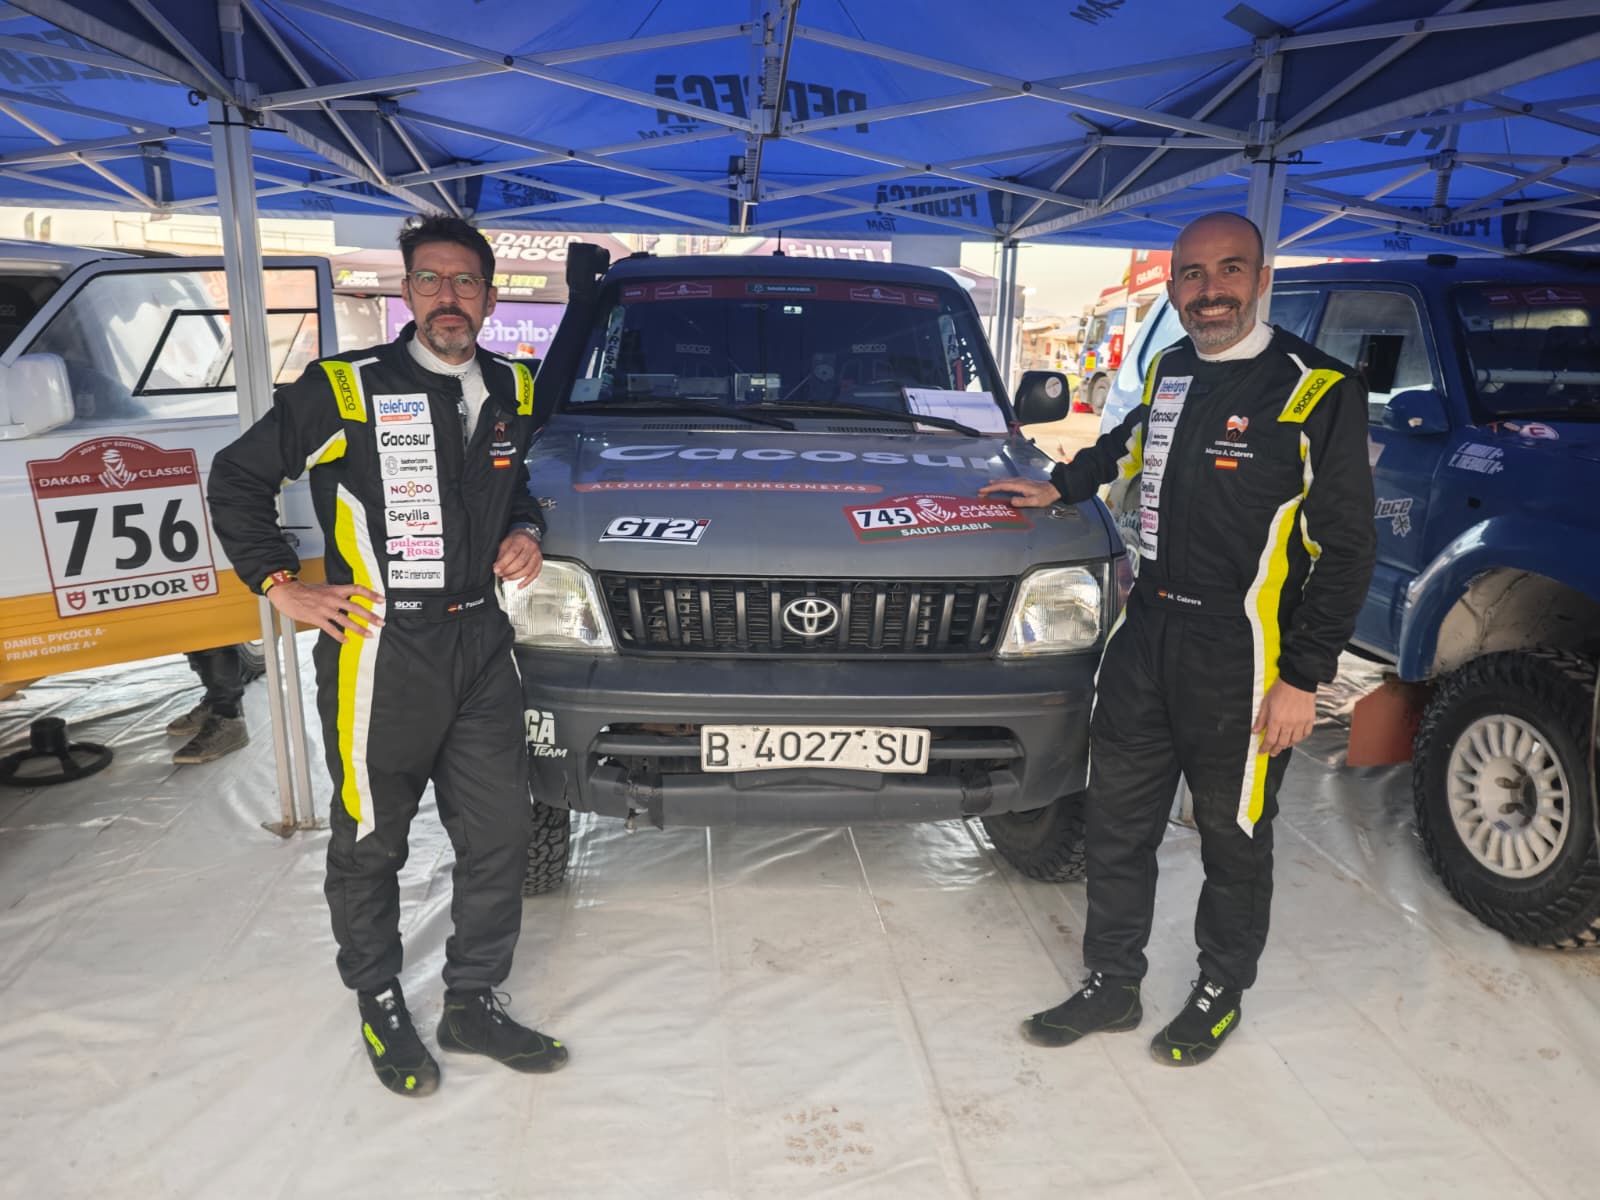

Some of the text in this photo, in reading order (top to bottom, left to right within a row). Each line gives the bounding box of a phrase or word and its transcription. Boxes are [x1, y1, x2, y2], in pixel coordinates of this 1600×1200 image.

[333, 368, 356, 412] sparco
[1293, 378, 1327, 415] sparco
[379, 399, 425, 417] telefurgo
[114, 441, 145, 451] EDITION
[38, 465, 193, 488] DAKAR CLASSIC
[735, 483, 867, 491] FURGONETAS
[388, 509, 430, 522] Sevilla
[959, 504, 1008, 512] DAKAR
[959, 510, 1016, 518] CLASSIC
[857, 508, 913, 528] 745
[606, 517, 709, 539] GT2i
[901, 522, 992, 537] SAUDI ARABIA
[55, 498, 199, 578] 756
[390, 539, 440, 550] pulseras
[406, 548, 440, 557] Rosas
[93, 578, 188, 605] TUDOR
[4, 636, 45, 650] DANIEL
[48, 628, 92, 642] PYCOCK
[6, 640, 97, 662] FRAN GOMEZ A+
[532, 743, 568, 758] TEAM
[707, 730, 923, 766] B 4027 SU
